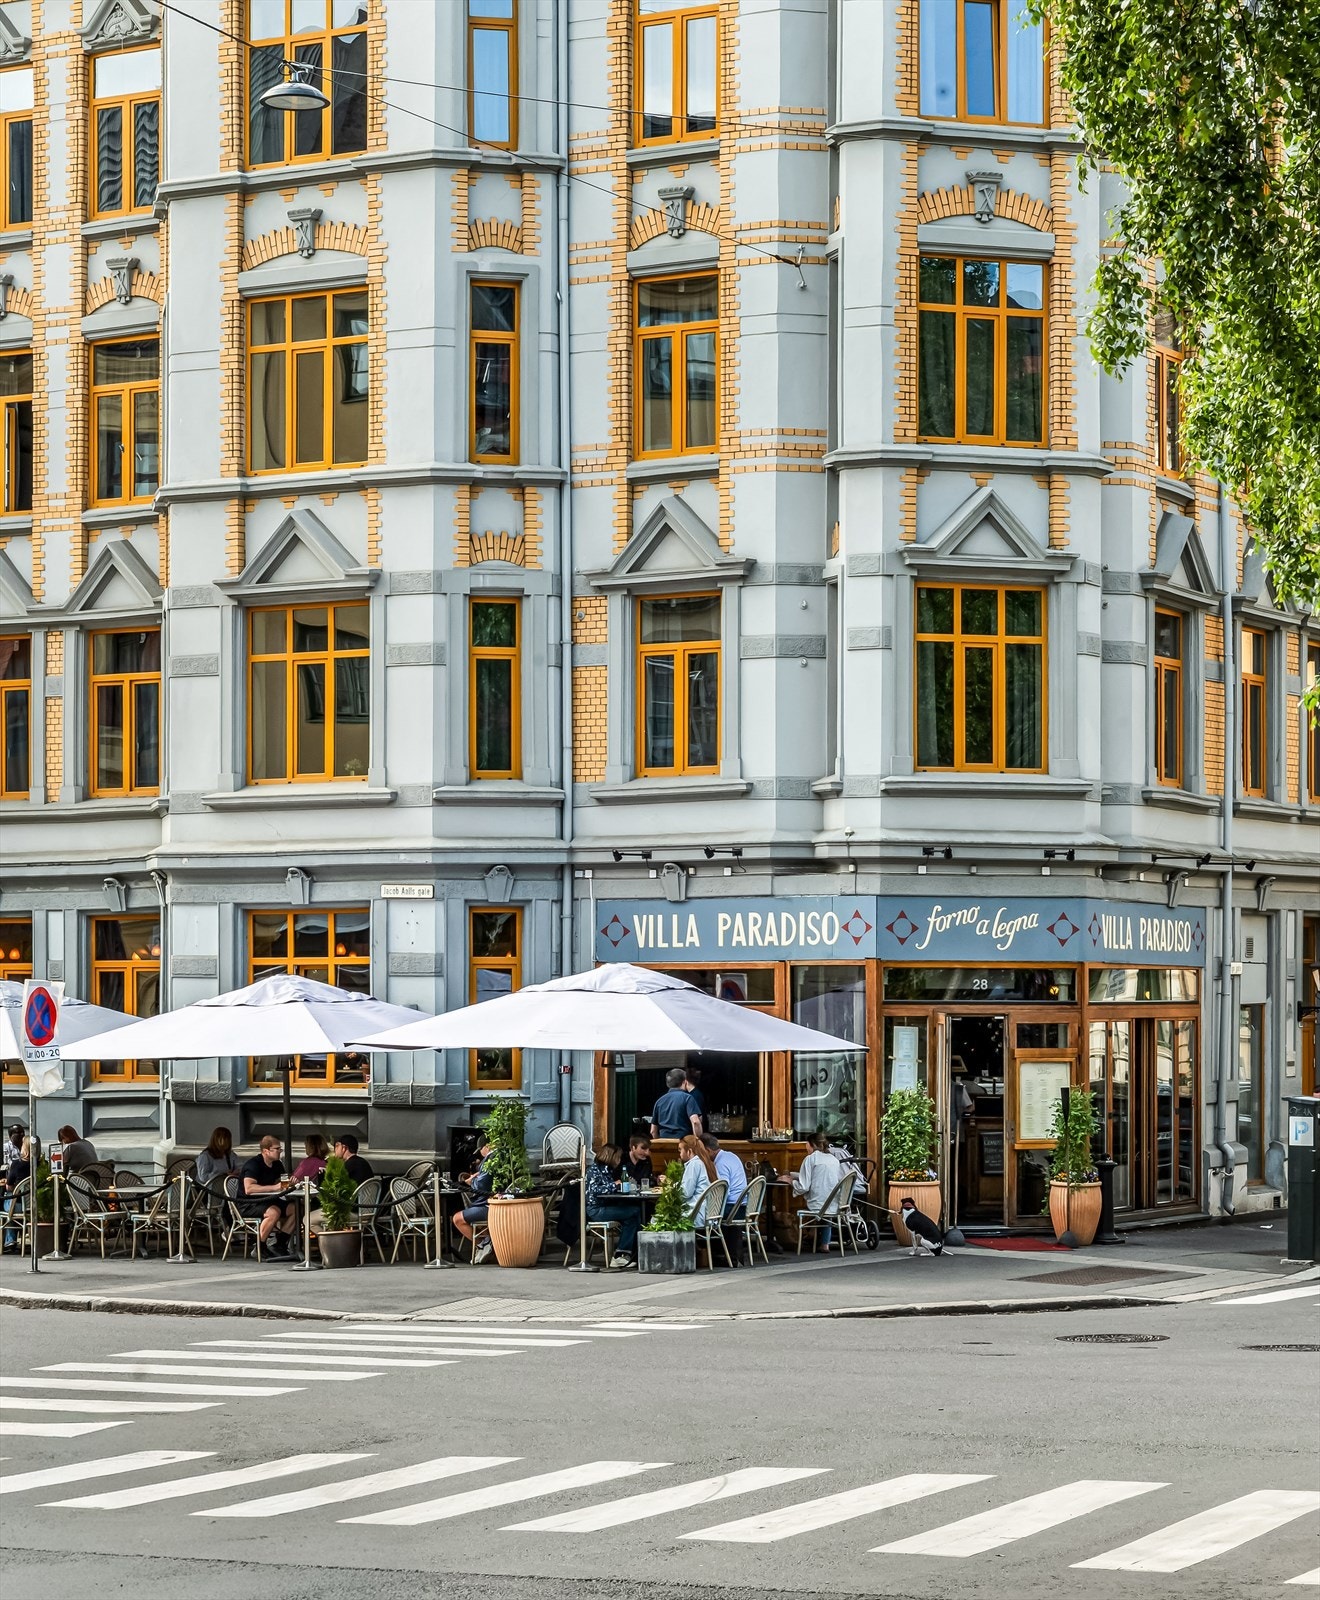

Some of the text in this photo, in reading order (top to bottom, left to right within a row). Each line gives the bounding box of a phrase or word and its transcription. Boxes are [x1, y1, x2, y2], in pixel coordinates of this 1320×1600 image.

[633, 911, 840, 948] VILLA PARADISO
[915, 905, 1039, 950] forno a legna
[1102, 913, 1192, 952] VILLA PARADISO
[972, 978, 988, 990] 28
[1294, 1120, 1309, 1141] P
